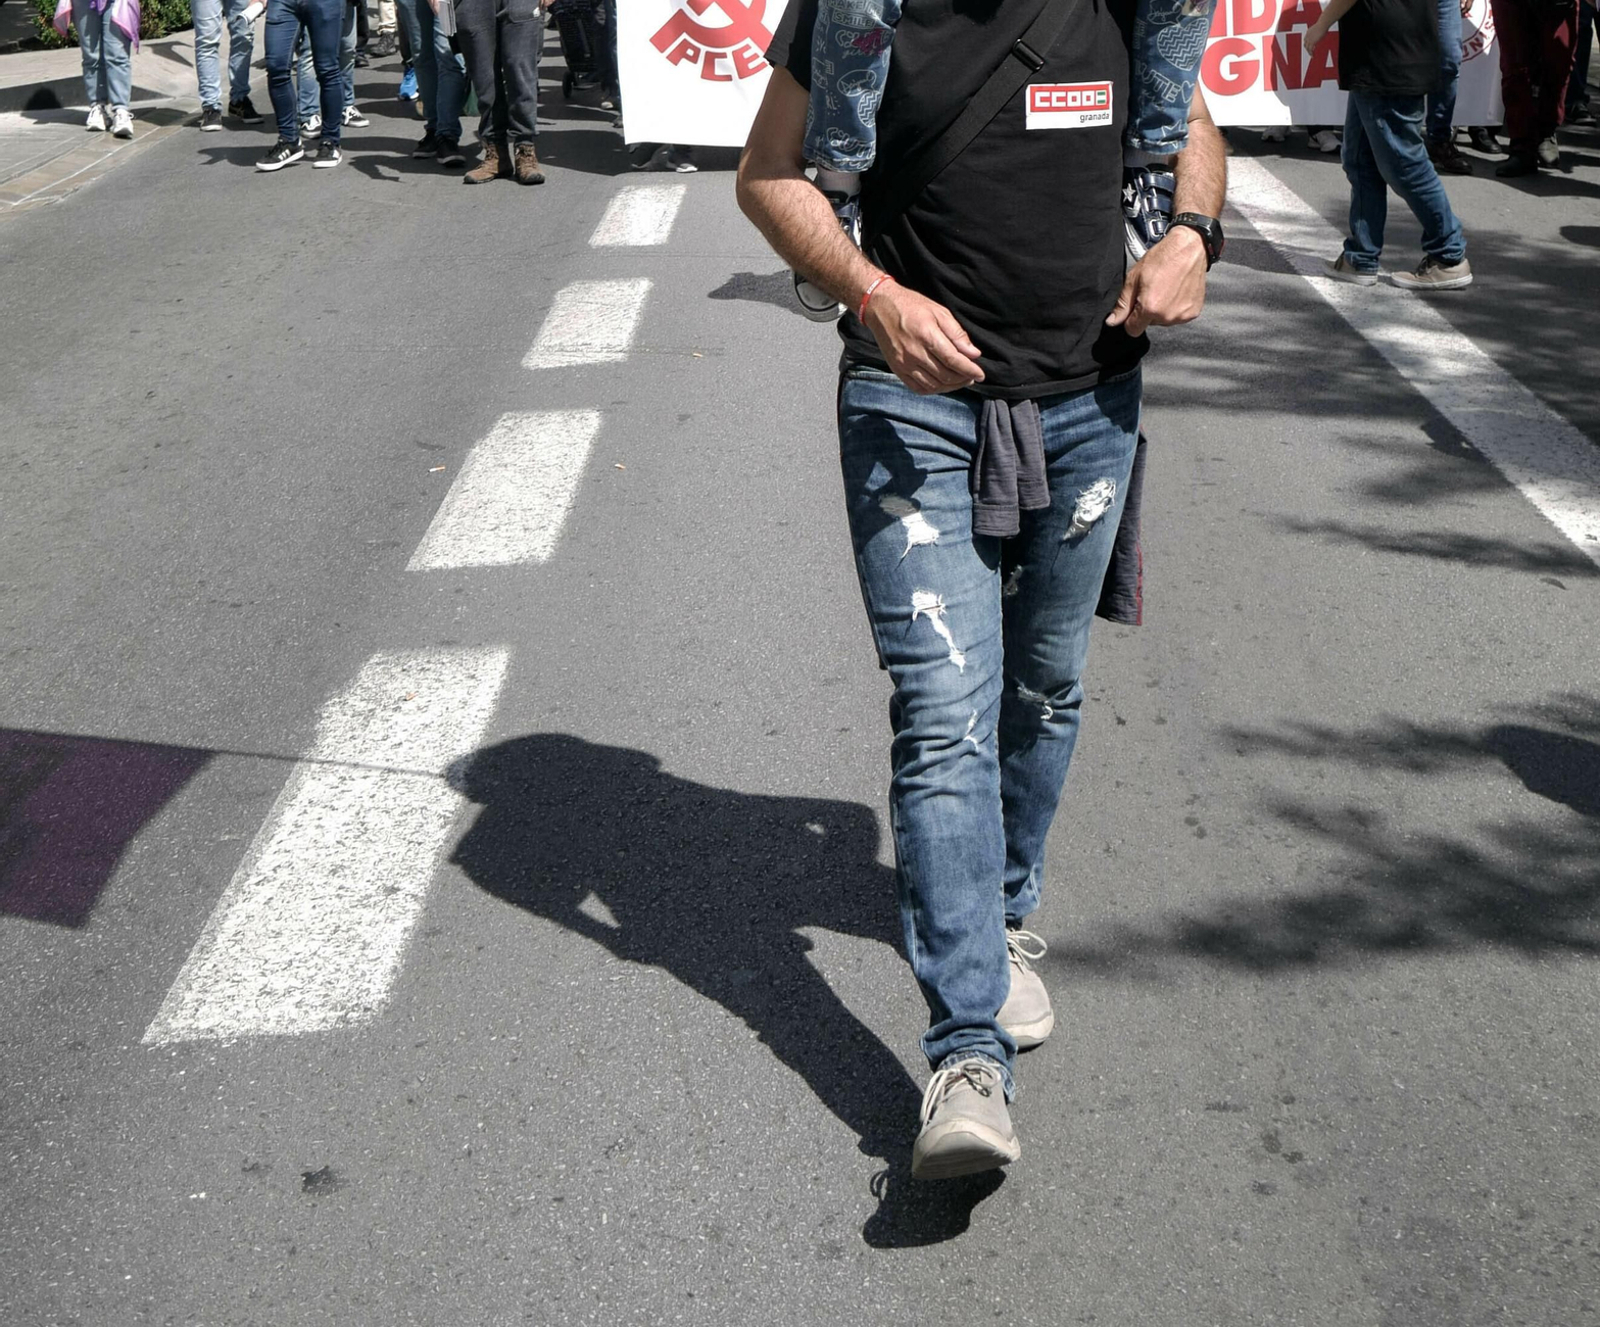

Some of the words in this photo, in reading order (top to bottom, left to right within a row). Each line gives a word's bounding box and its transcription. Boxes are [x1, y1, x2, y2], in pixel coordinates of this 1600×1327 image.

[666, 38, 768, 82] PCE
[1200, 31, 1340, 96] GNA
[1035, 90, 1096, 108] CCOO
[1080, 112, 1110, 123] granada
